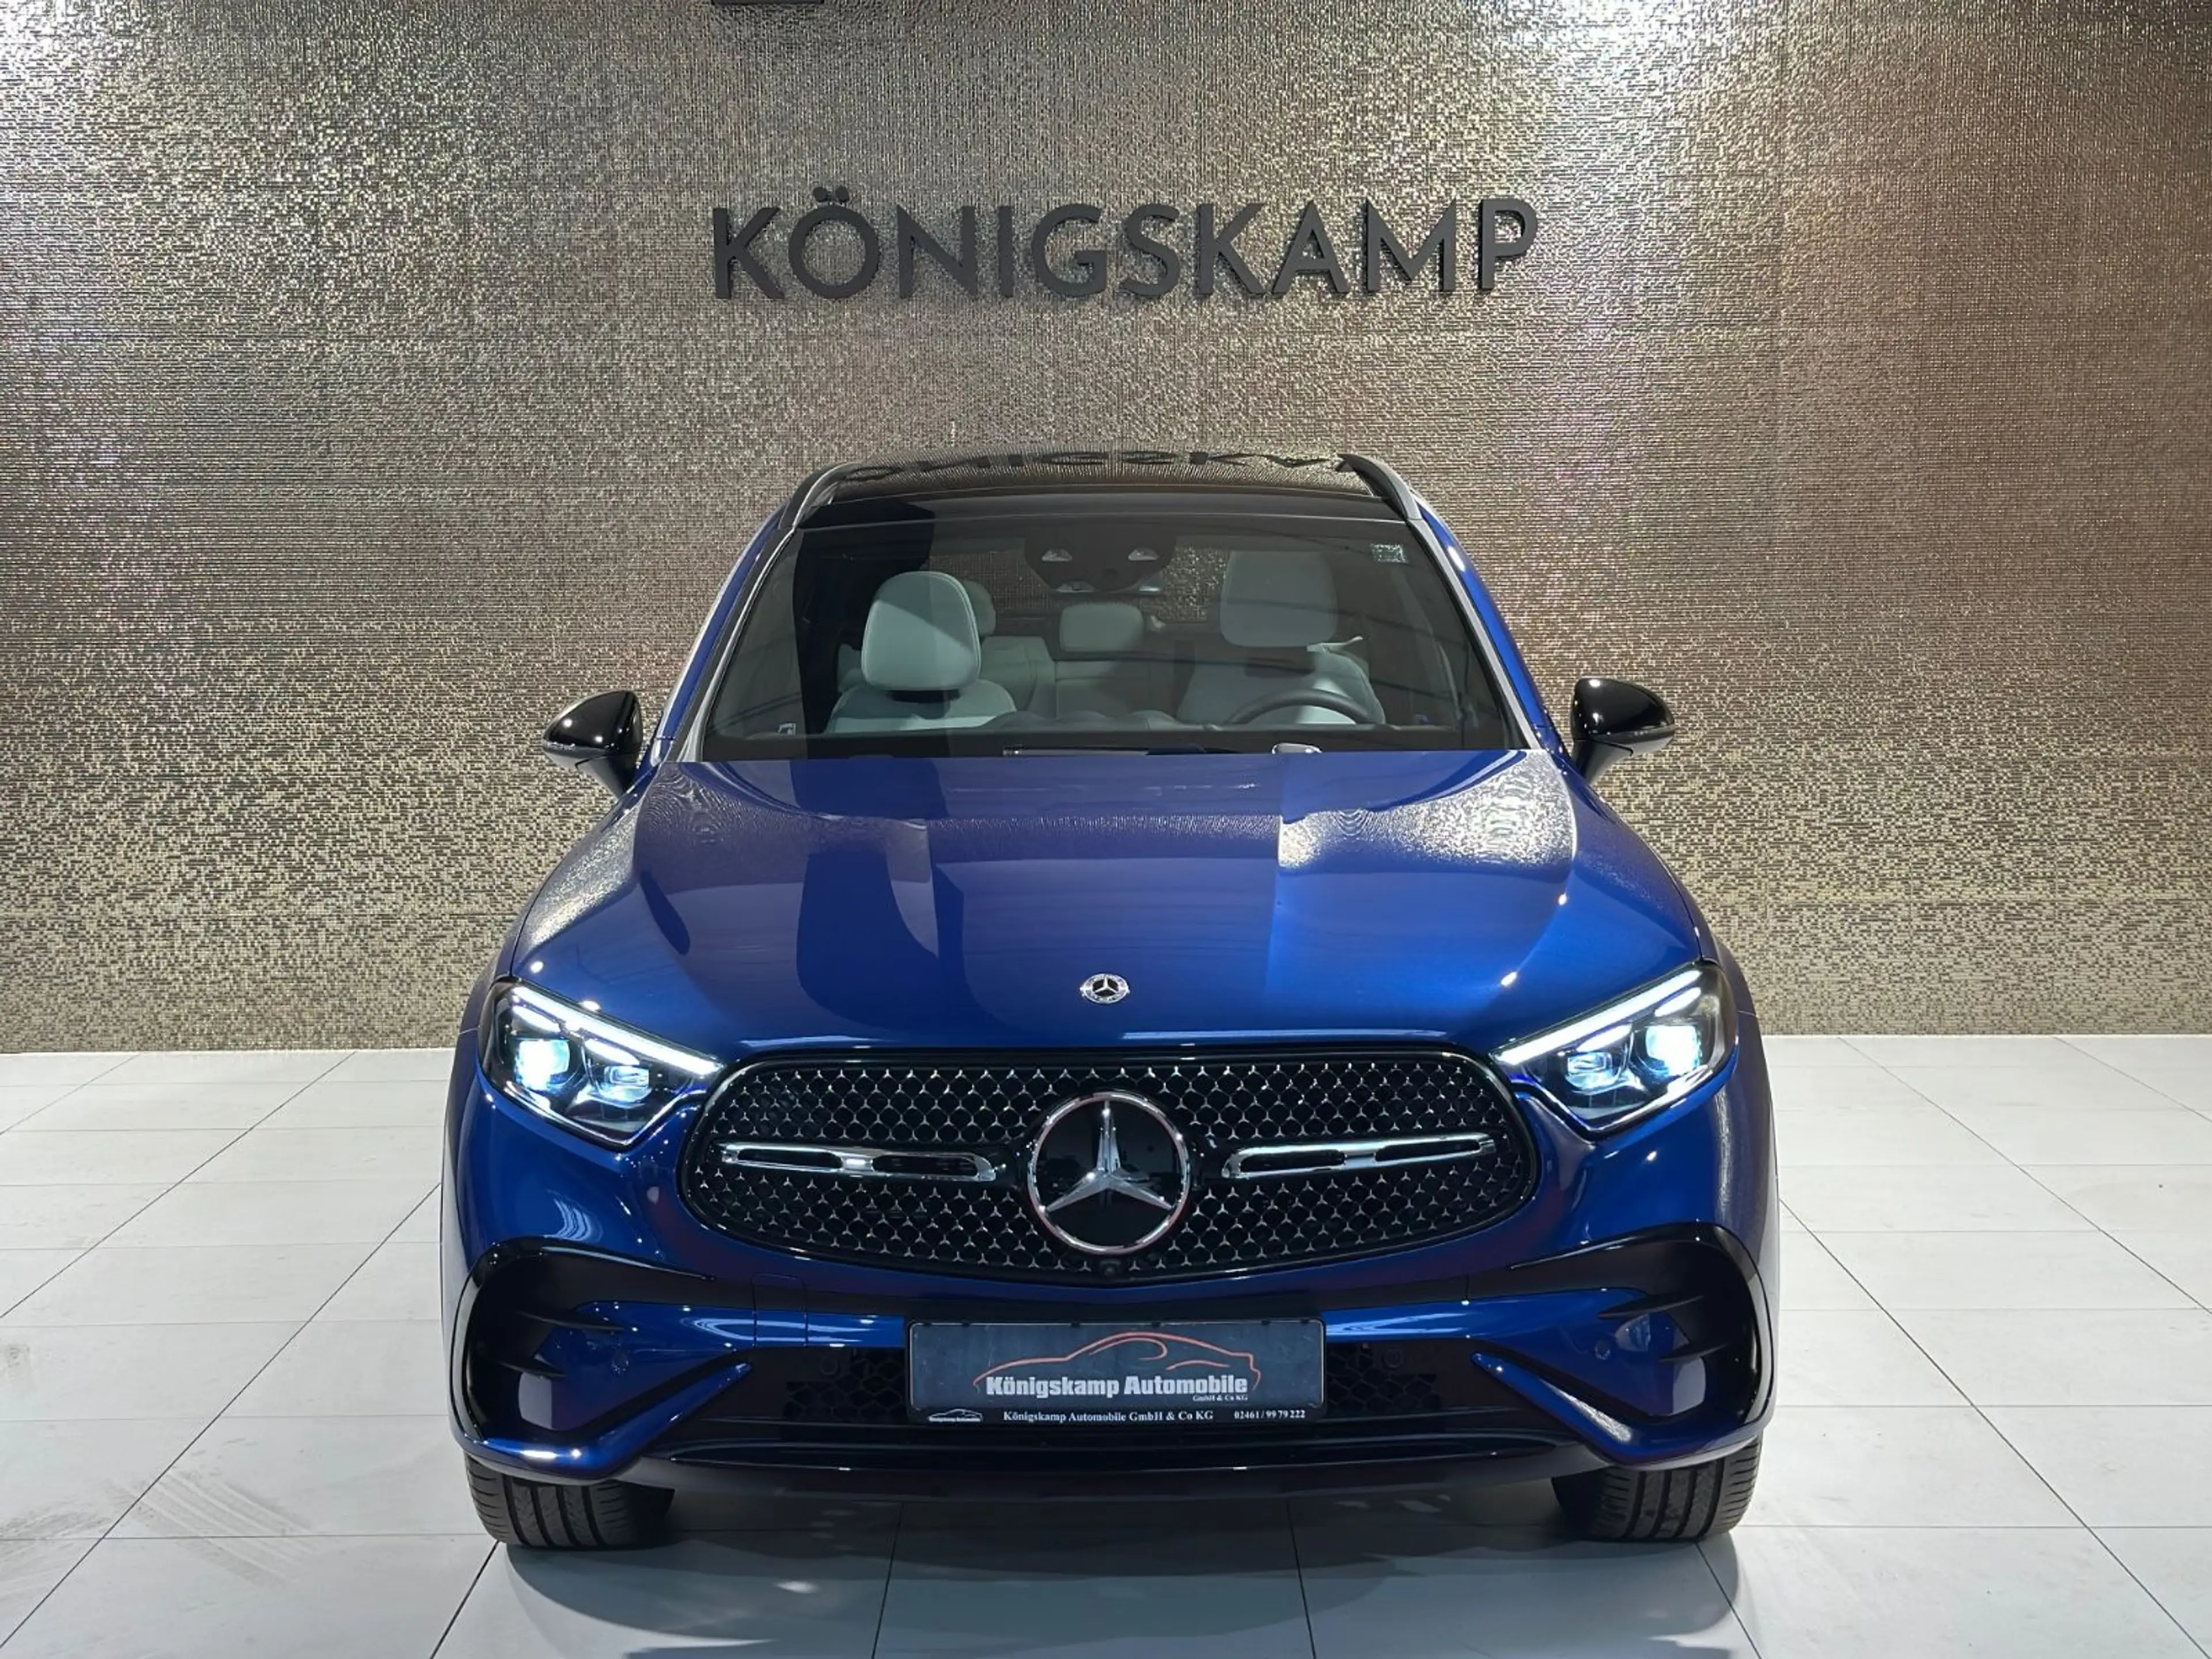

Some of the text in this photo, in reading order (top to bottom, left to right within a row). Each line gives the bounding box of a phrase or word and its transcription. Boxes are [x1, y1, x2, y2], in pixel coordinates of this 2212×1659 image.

[713, 185, 1537, 297] KÖNIGSKAMP
[986, 1374, 1248, 1398] Königskamp Automobile
[1003, 1410, 1214, 1423] Königskamp Automobile GmbH & Co KG
